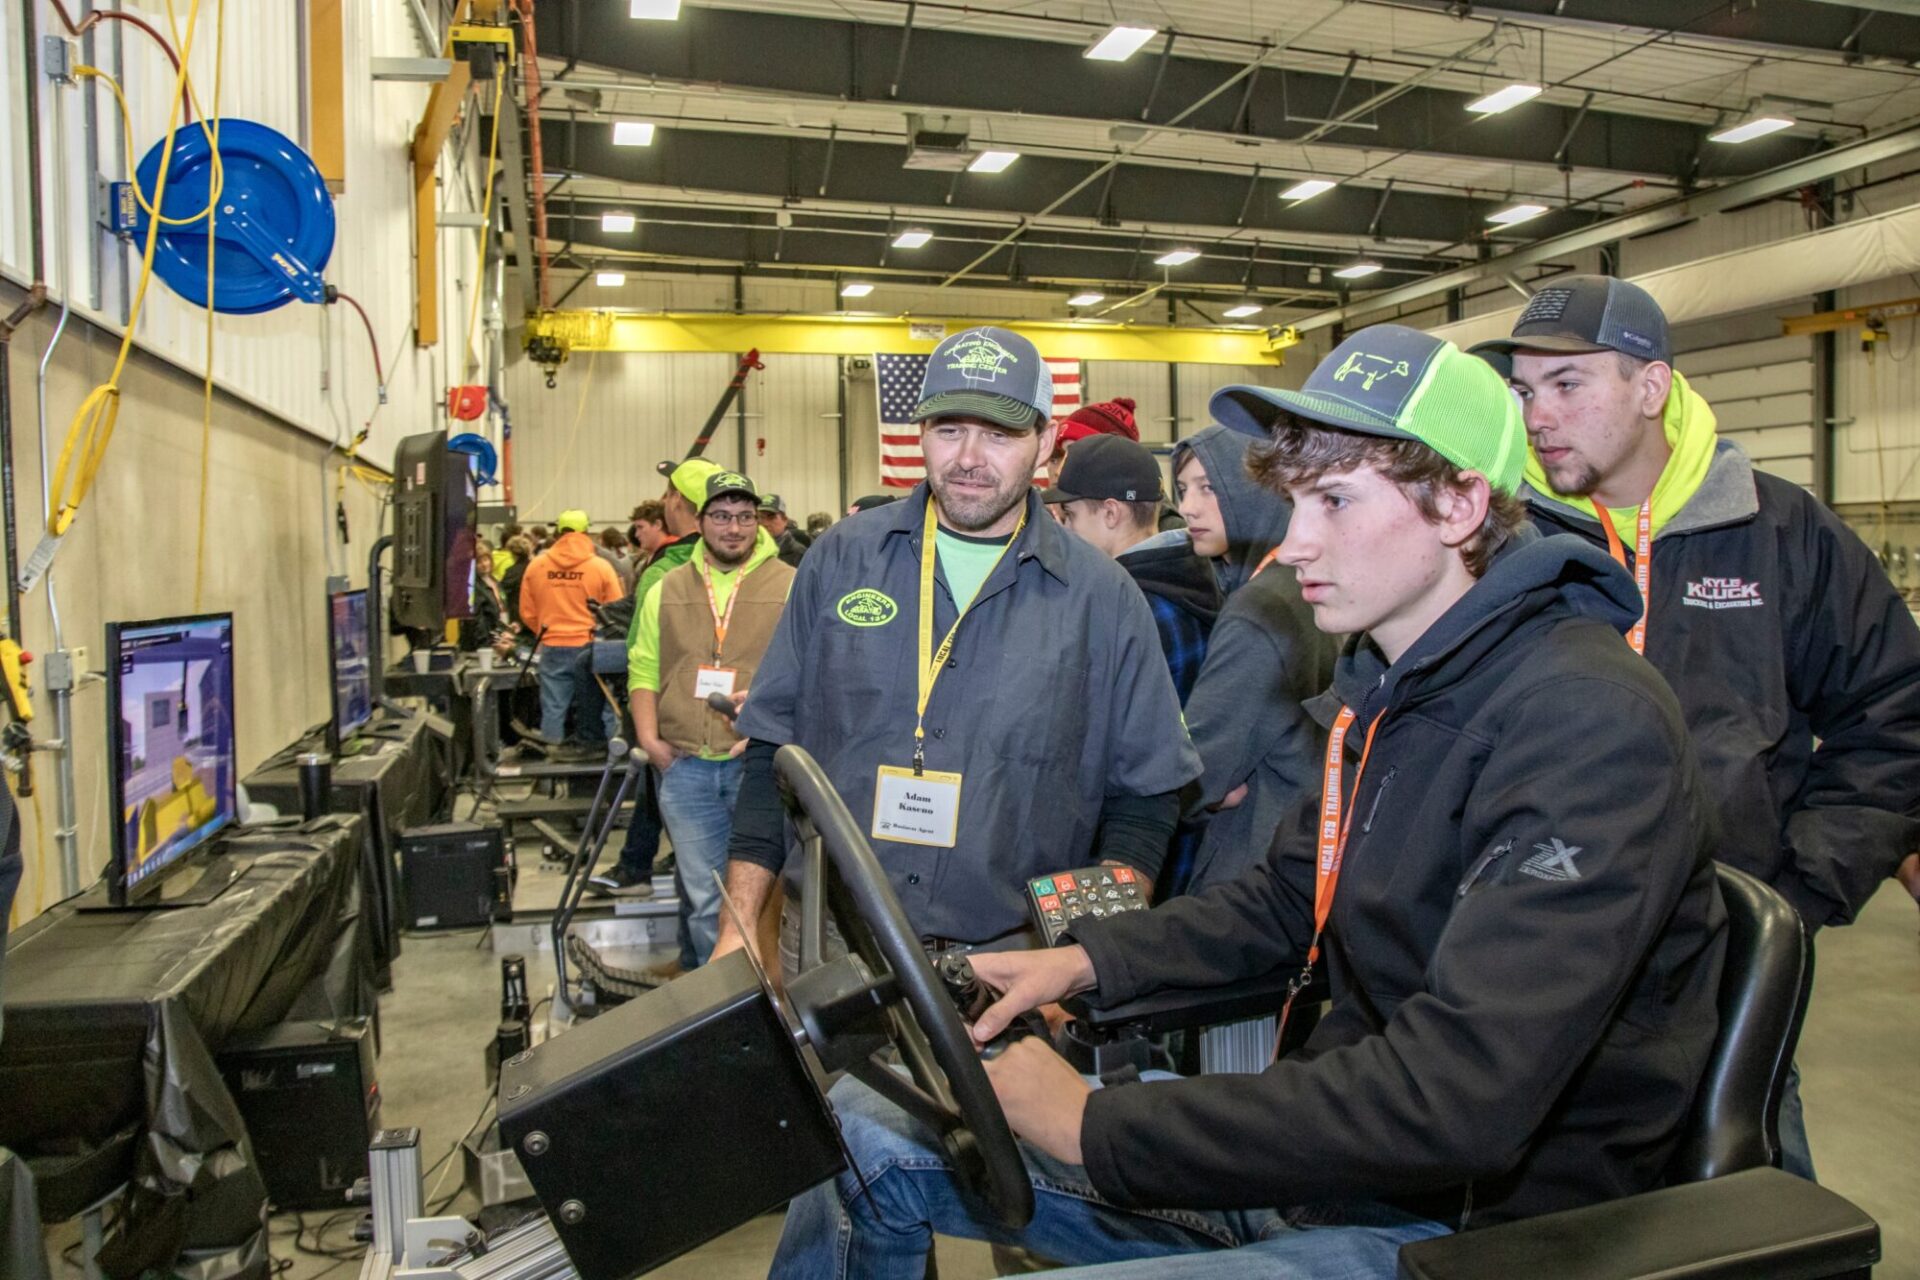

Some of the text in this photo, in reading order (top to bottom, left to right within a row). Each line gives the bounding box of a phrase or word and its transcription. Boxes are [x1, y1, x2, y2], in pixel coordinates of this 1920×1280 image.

[979, 364, 1007, 374] CENTER
[1639, 535, 1649, 556] LOCAL
[547, 570, 584, 580] BOLDT
[1702, 576, 1742, 588] KYLE
[1686, 582, 1760, 599] KLUCK
[846, 593, 891, 608] ENGINEERS
[844, 610, 887, 622] LOCAL 139
[935, 644, 951, 663] LOCAL
[904, 792, 931, 803] Adam
[1321, 727, 1345, 876] LOCAL 139 TRAINING CENTER
